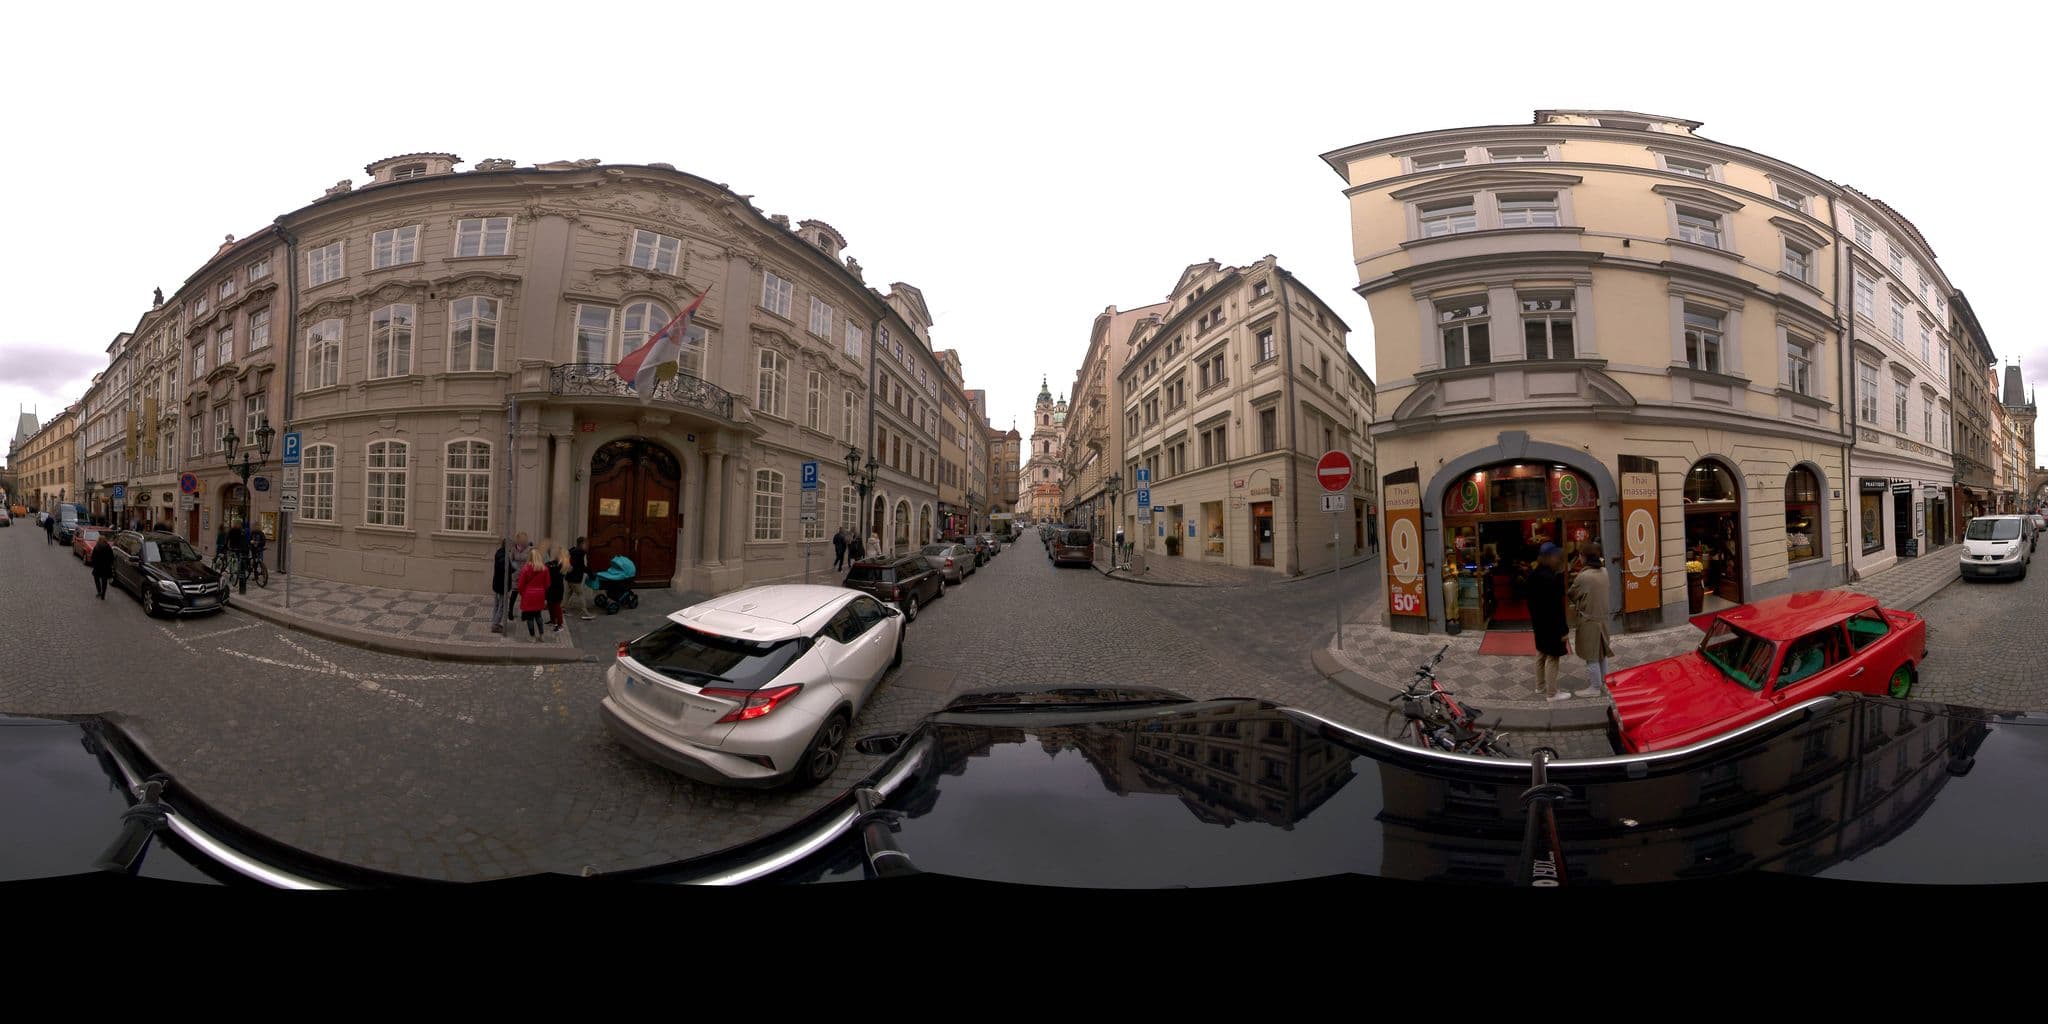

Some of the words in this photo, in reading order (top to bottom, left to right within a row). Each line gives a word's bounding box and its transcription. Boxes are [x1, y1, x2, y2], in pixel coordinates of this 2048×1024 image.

[287, 437, 297, 455] P
[805, 465, 814, 481] P
[1632, 476, 1648, 485] Thai
[1140, 491, 1147, 502] P
[1394, 487, 1410, 496] Thai
[1461, 480, 1479, 512] 9
[1559, 474, 1579, 506] 9
[1623, 487, 1656, 497] massage
[1386, 496, 1418, 506] massage
[1391, 518, 1420, 584] 9
[1627, 508, 1656, 578] 9
[1394, 593, 1420, 611] 50%
